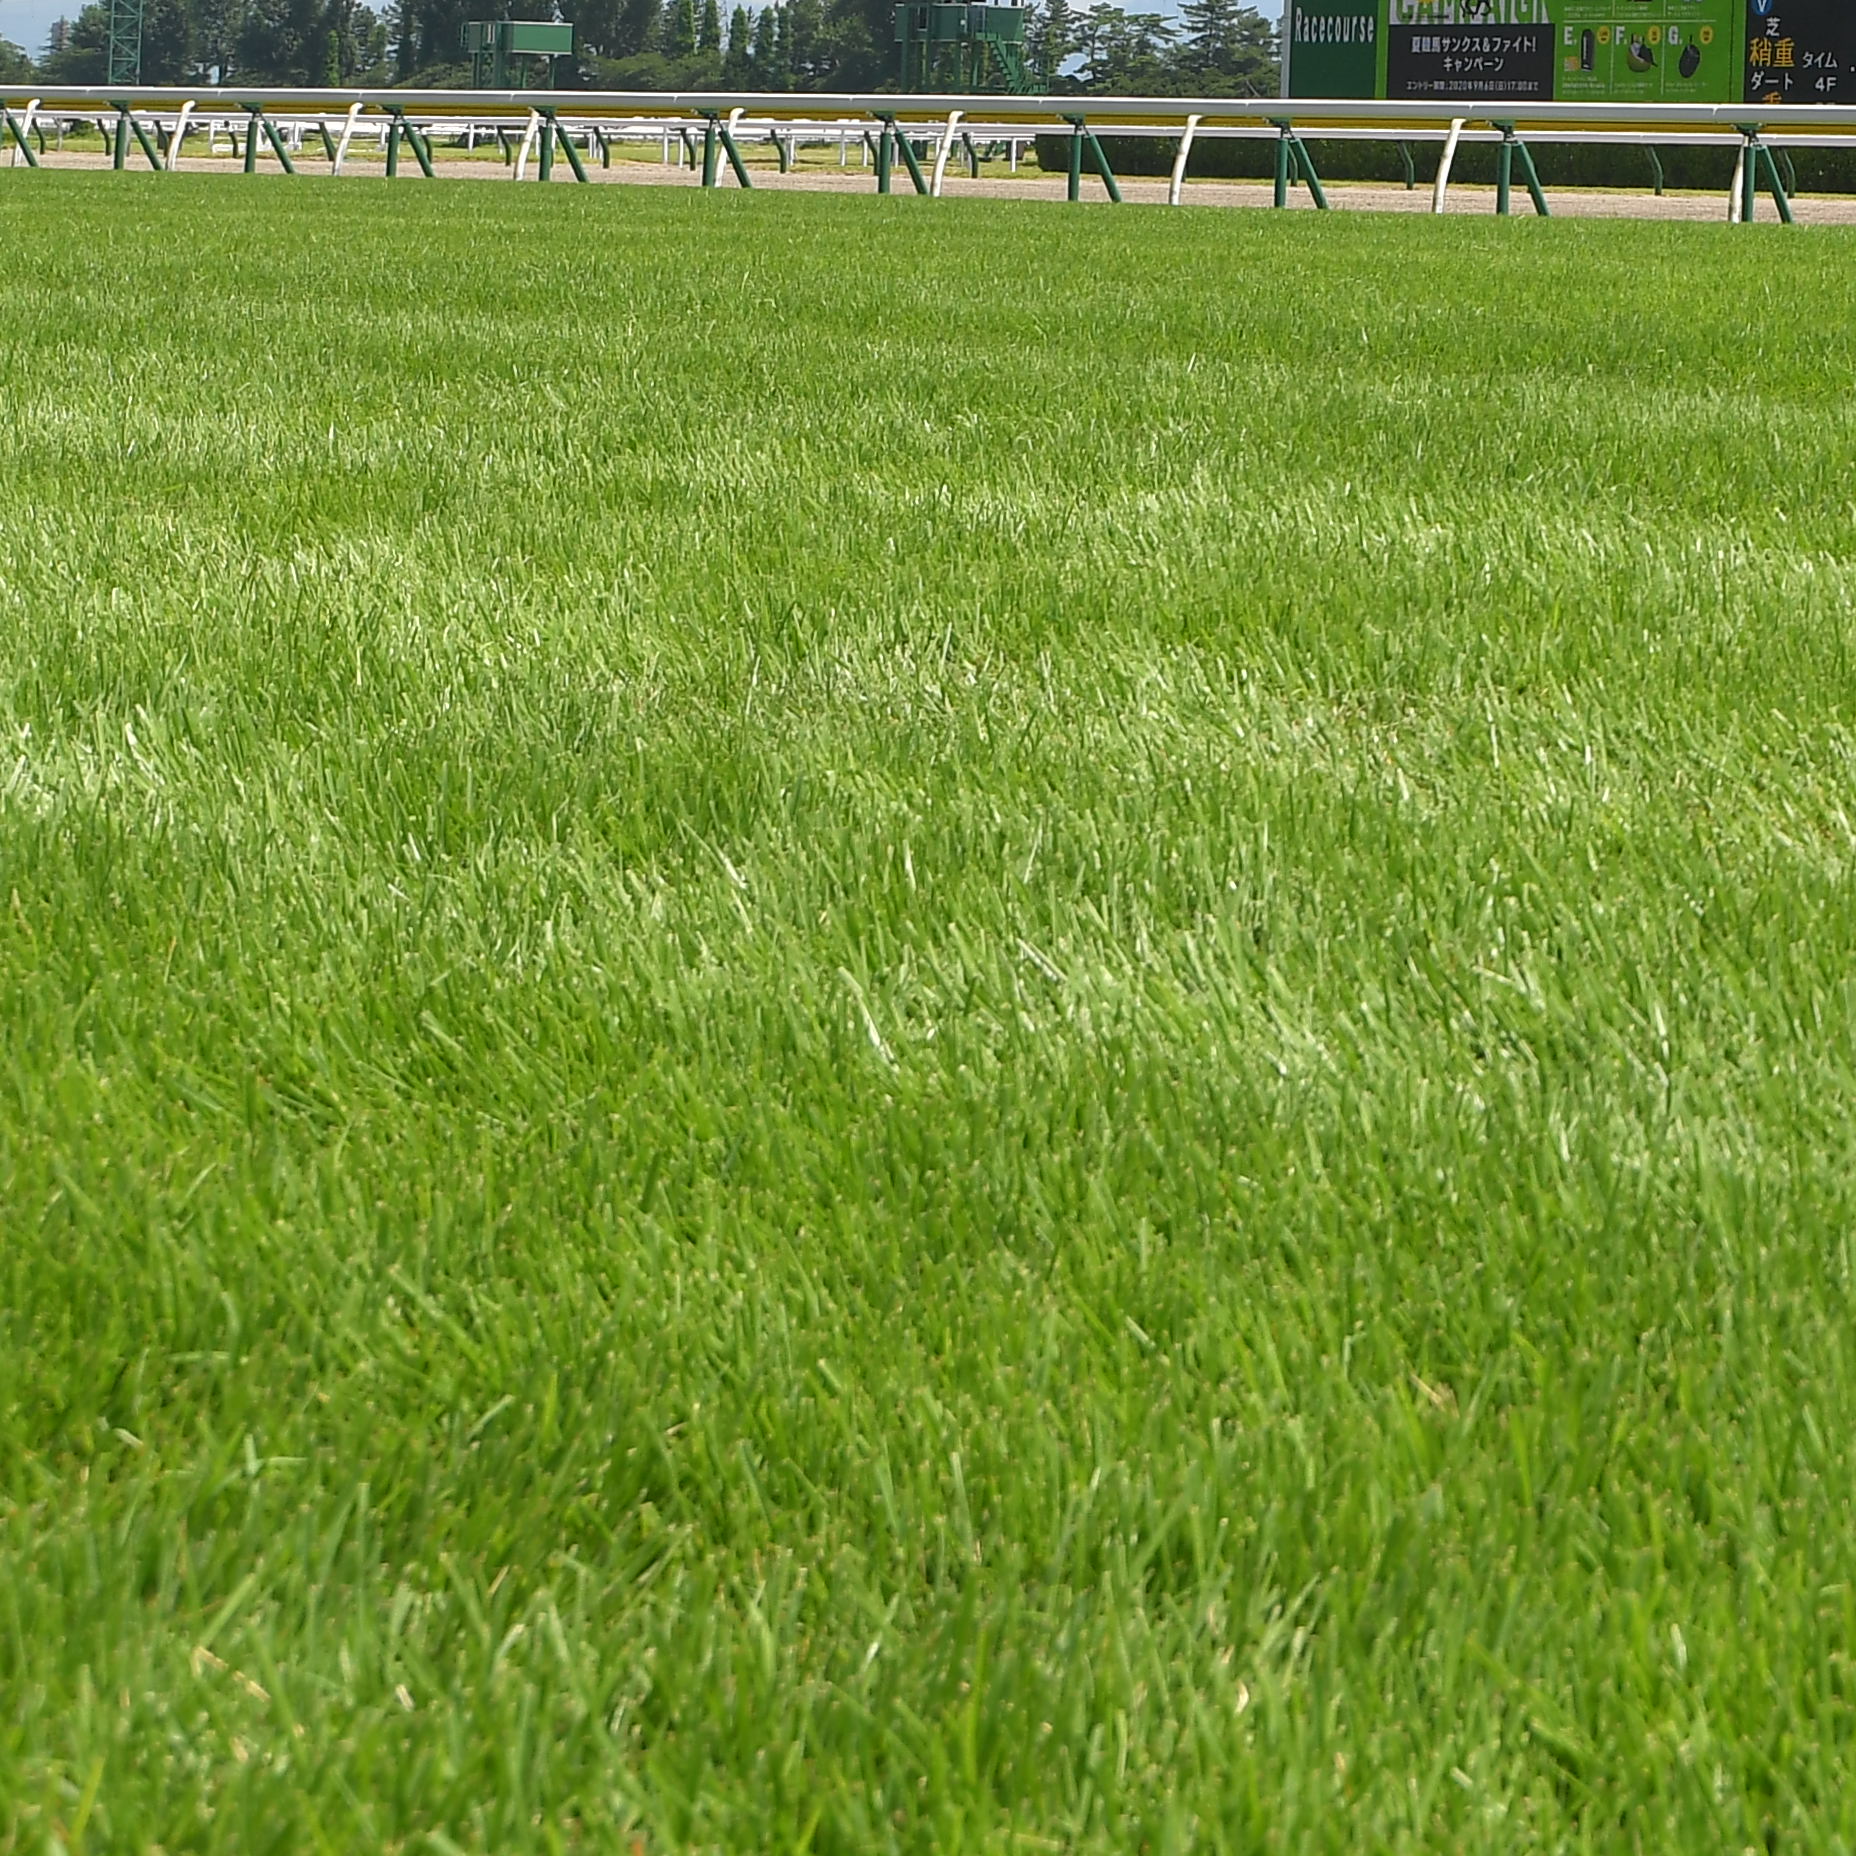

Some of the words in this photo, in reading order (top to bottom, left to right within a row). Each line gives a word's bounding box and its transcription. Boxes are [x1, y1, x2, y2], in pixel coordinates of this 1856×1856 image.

[1295, 7, 1375, 44] Racecourse
[1766, 17, 1781, 36] 芝
[1750, 38, 1795, 67] 稍重
[1802, 51, 1838, 68] タイム
[1443, 56, 1504, 72] キャンペーン
[1751, 71, 1793, 90] ダート
[1815, 77, 1837, 92] 4F
